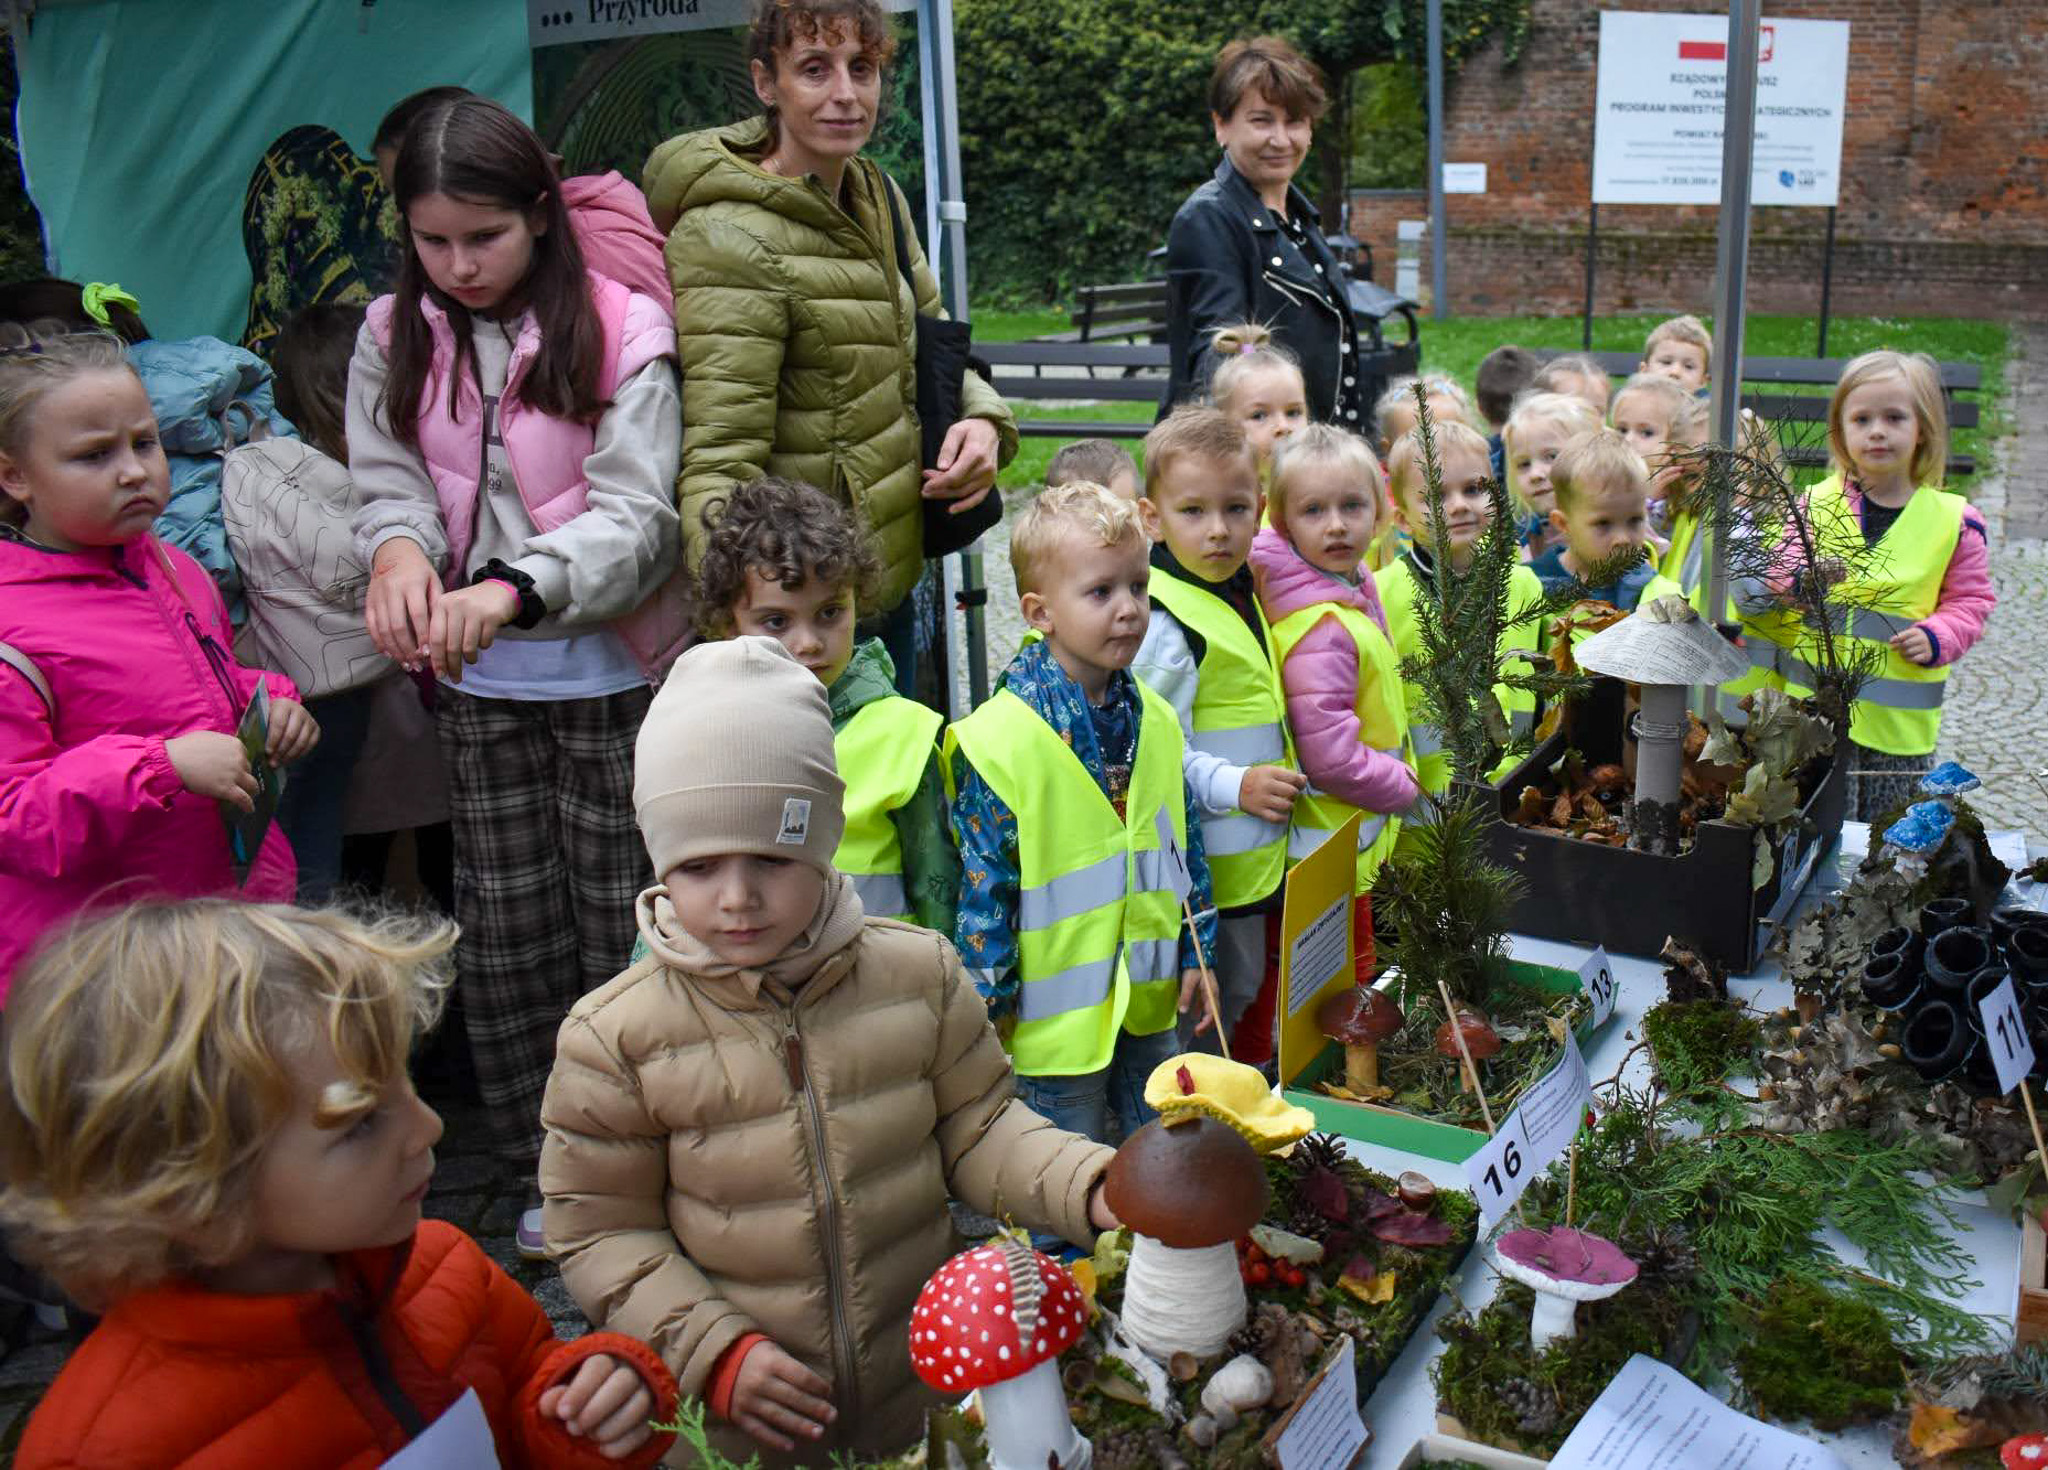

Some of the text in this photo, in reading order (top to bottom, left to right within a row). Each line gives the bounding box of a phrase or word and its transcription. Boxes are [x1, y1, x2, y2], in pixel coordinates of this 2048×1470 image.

[590, 0, 698, 25] Przyroda
[1610, 102, 1832, 116] PROGRAM INWESTYC ATEGICZNYCH
[1592, 968, 1612, 1005] 13
[1996, 1004, 2024, 1060] 11
[1483, 1140, 1522, 1197] 16
